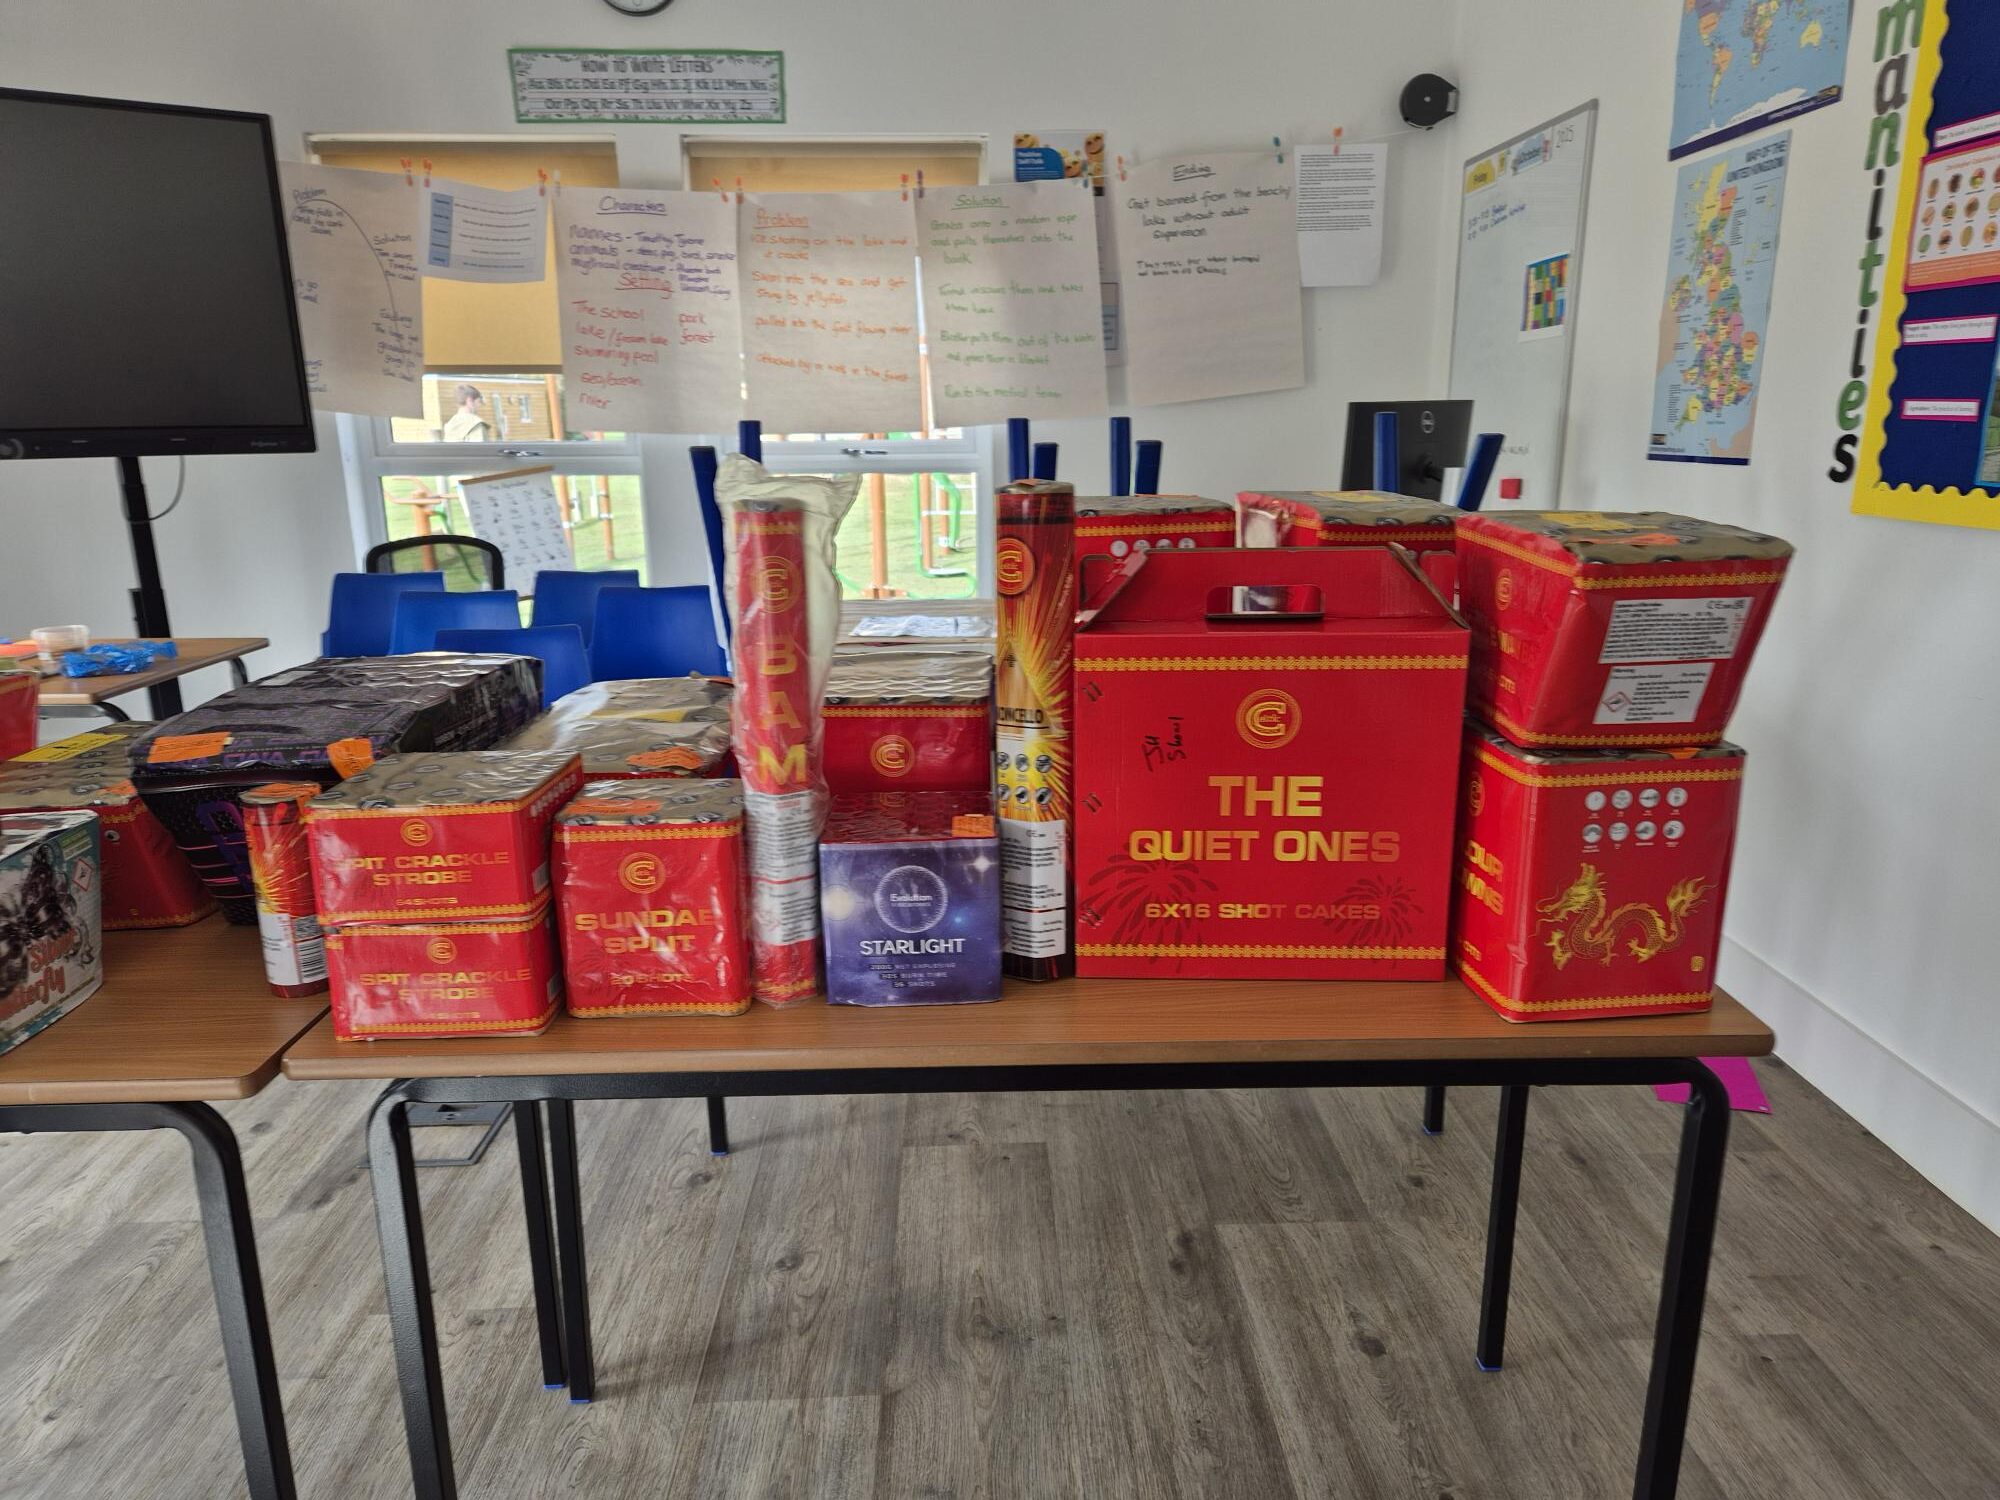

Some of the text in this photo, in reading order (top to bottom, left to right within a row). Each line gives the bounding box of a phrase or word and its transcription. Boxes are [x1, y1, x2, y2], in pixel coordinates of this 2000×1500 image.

[613, 60, 628, 73] TO
[670, 61, 713, 73] LETTERS
[1208, 775, 1324, 817] THE
[1129, 830, 1400, 863] QUIET ONES
[395, 851, 510, 869] CRACKLE
[373, 870, 473, 887] STROBE
[890, 894, 933, 902] Evolution
[574, 908, 718, 931] SUNDAE
[1144, 903, 1381, 921] 6X16 SHOT CAKES
[604, 934, 696, 954] SPLIT
[859, 938, 966, 956] STARLIGHT
[359, 968, 533, 987] SPIT CRACKLE
[398, 987, 496, 1001] STROBE
